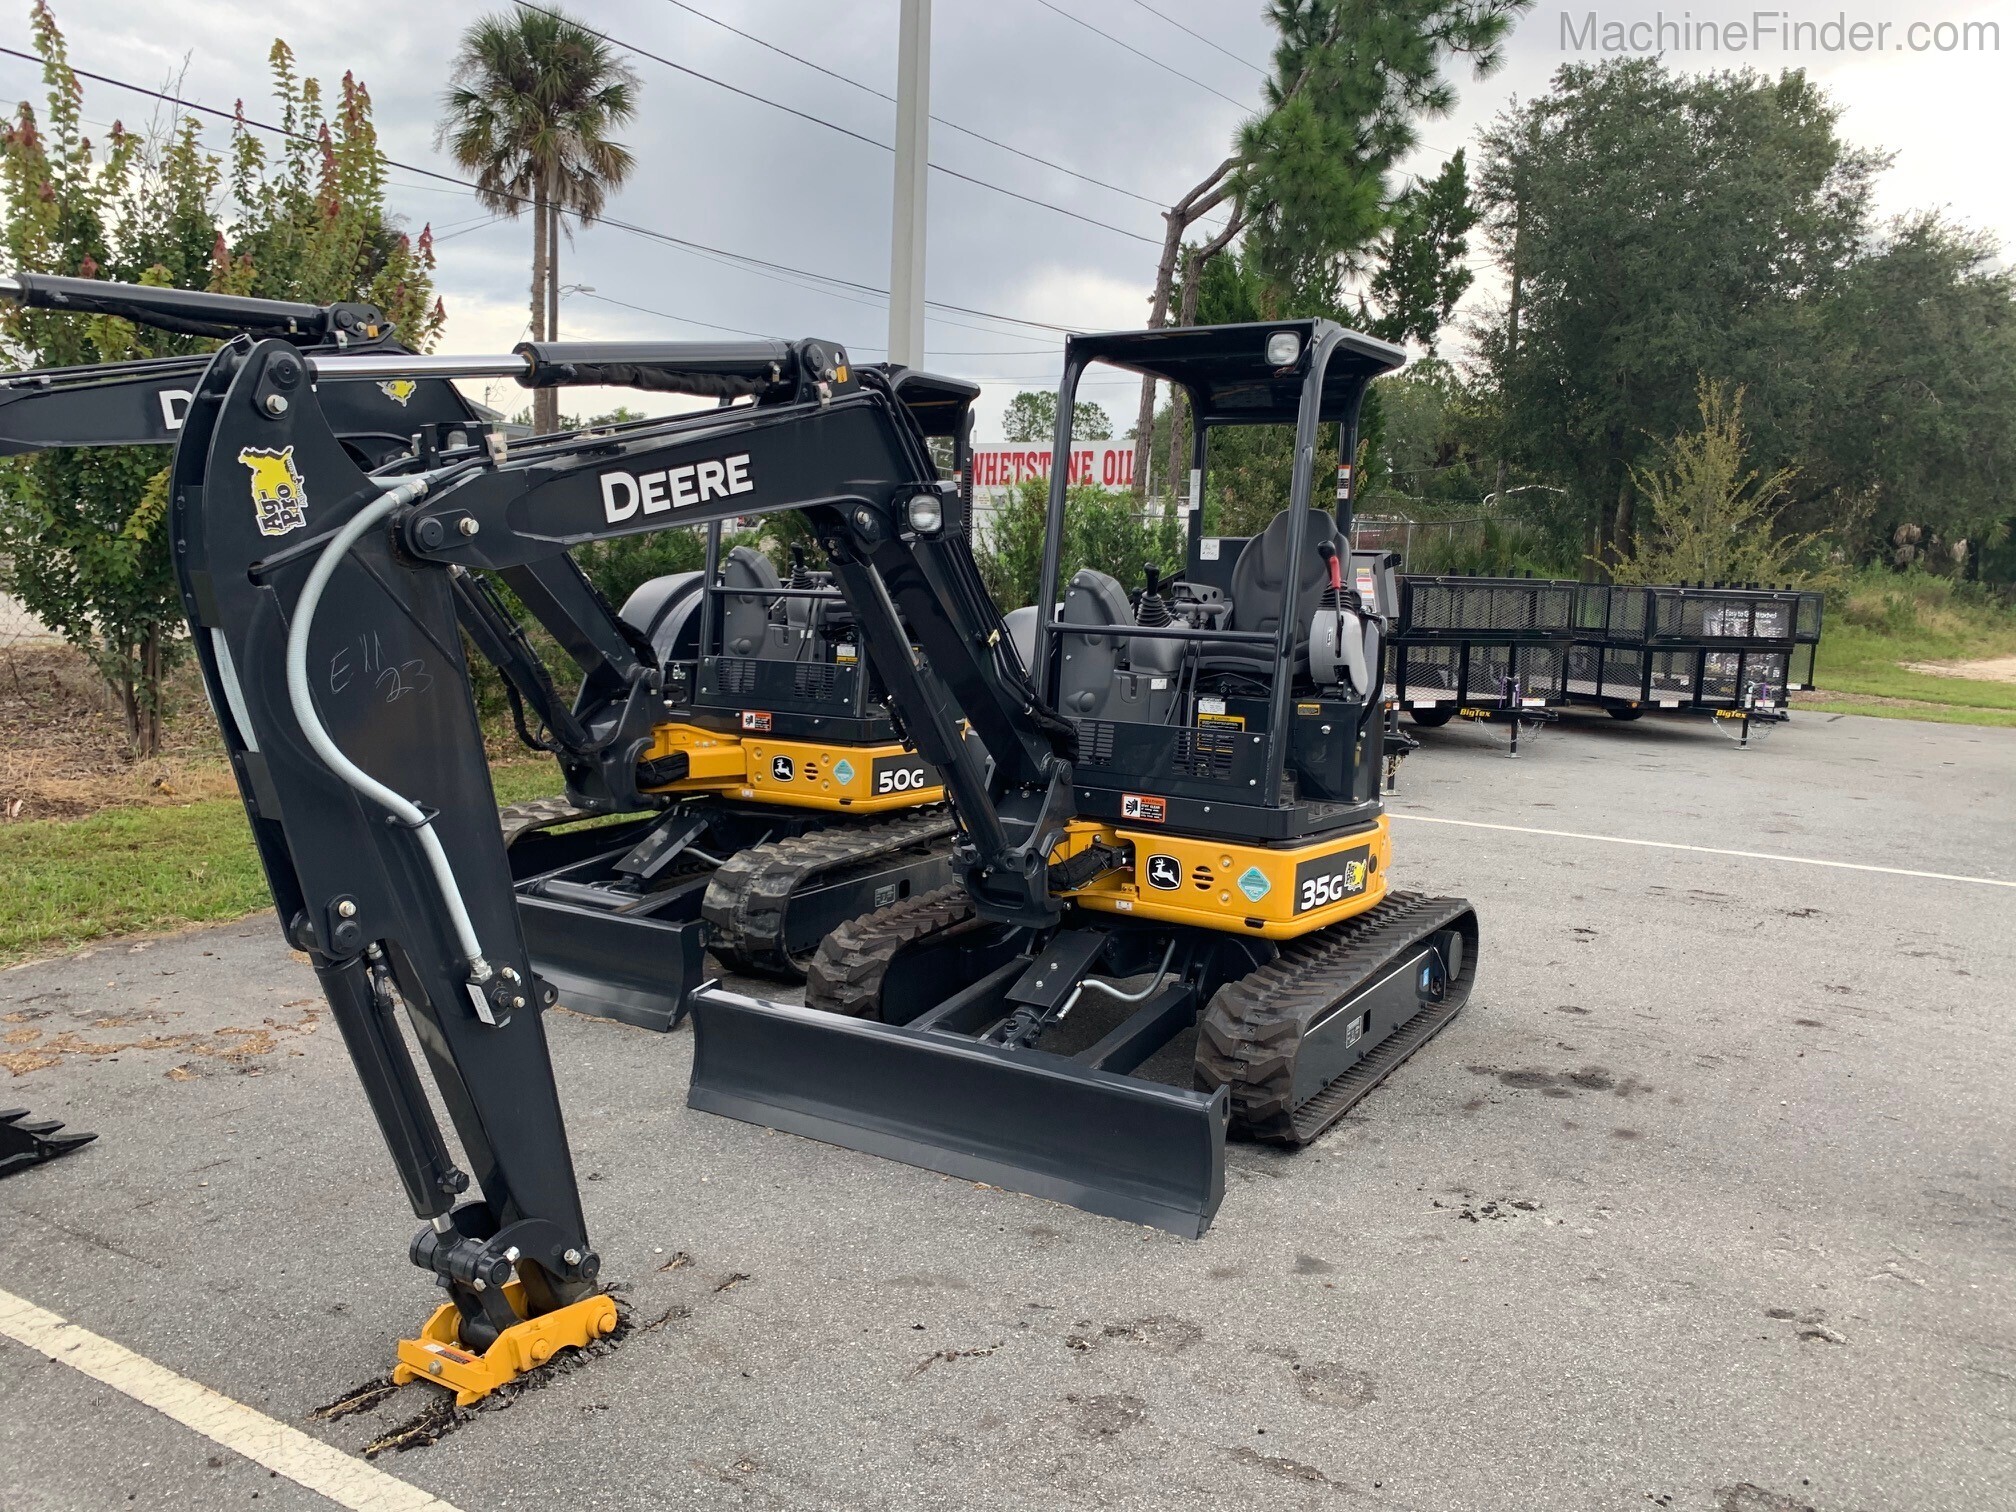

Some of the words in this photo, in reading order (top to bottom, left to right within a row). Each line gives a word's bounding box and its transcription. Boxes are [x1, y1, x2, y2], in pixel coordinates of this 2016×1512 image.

[973, 451, 1094, 486] WHETSTNE
[1103, 449, 1133, 486] OIL
[277, 484, 302, 527] Pro
[600, 454, 754, 524] DEERE
[879, 768, 924, 793] 50G
[1301, 875, 1343, 910] 35G
